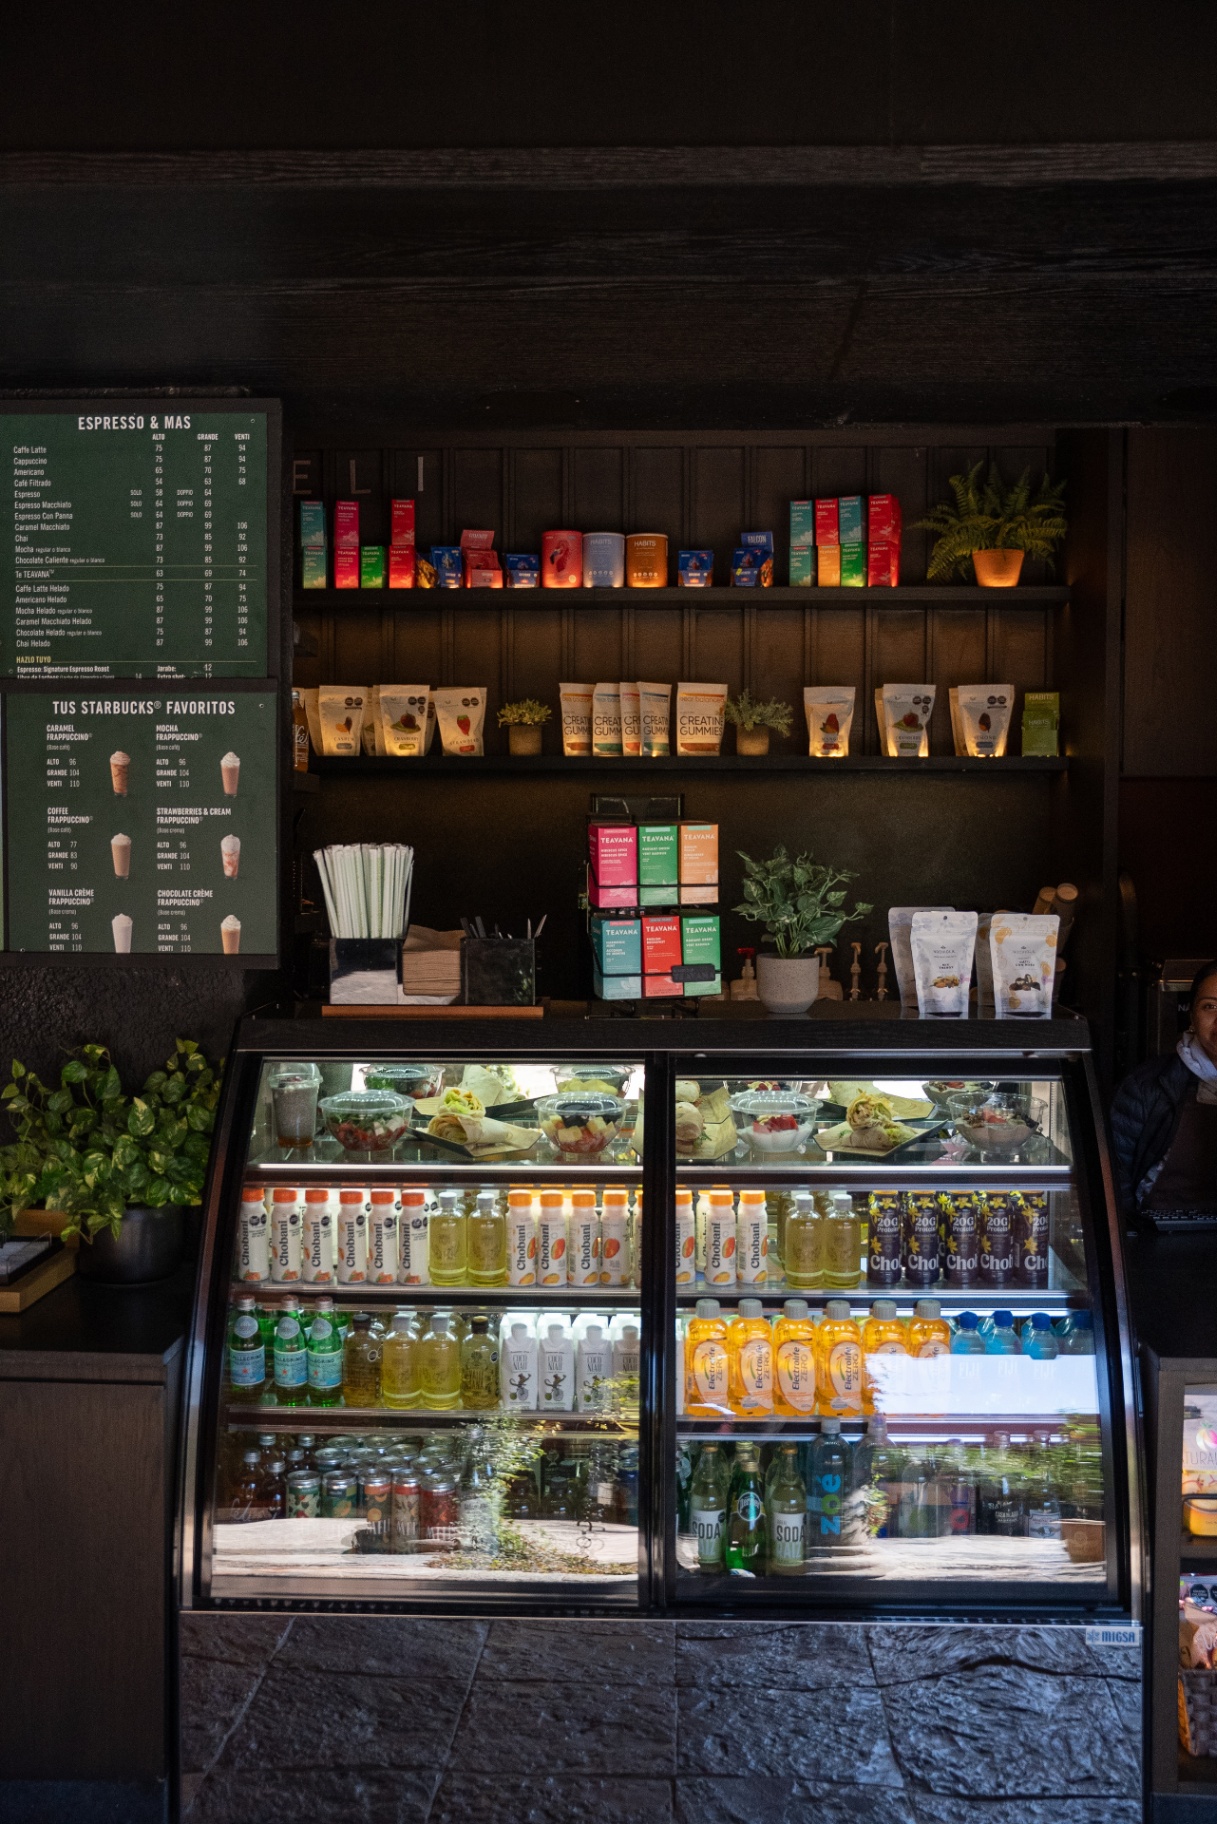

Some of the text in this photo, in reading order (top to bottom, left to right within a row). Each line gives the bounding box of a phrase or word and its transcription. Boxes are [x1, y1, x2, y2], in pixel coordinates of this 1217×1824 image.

[78, 415, 191, 430] ESPRESSO & MAS
[747, 535, 766, 544] FALCON
[53, 701, 76, 714] TUS
[167, 701, 235, 714] FAVORITOS
[680, 727, 722, 735] GUMMIES
[157, 808, 202, 816] STRAWBERRIES
[210, 808, 231, 816] CREAM
[48, 888, 94, 897] VANILLA CRÈME
[158, 888, 213, 898] CHOCOLATE CRÈME
[878, 1217, 898, 1226] 20G
[915, 1217, 936, 1226] 20G
[953, 1217, 973, 1226] 20G
[987, 1217, 1007, 1226] 20G
[242, 1220, 250, 1266] Chobani
[278, 1221, 288, 1266] Chobani
[311, 1221, 321, 1267] Chobani
[346, 1221, 355, 1268] Chobani
[374, 1223, 382, 1269] Chobani
[400, 1223, 410, 1269] Chobani
[517, 1224, 525, 1271] Chobani
[540, 1224, 549, 1270] Chobani
[581, 1224, 590, 1270] Chobani
[711, 1222, 721, 1269] Chobani
[751, 1222, 760, 1269] Chobani
[792, 1347, 800, 1390] Electrolife
[800, 1354, 808, 1382] ZERO
[817, 1474, 841, 1535] zoé
[691, 1521, 720, 1539] SODA
[777, 1525, 804, 1542] SODA
[1102, 1631, 1135, 1643] MIGSA
